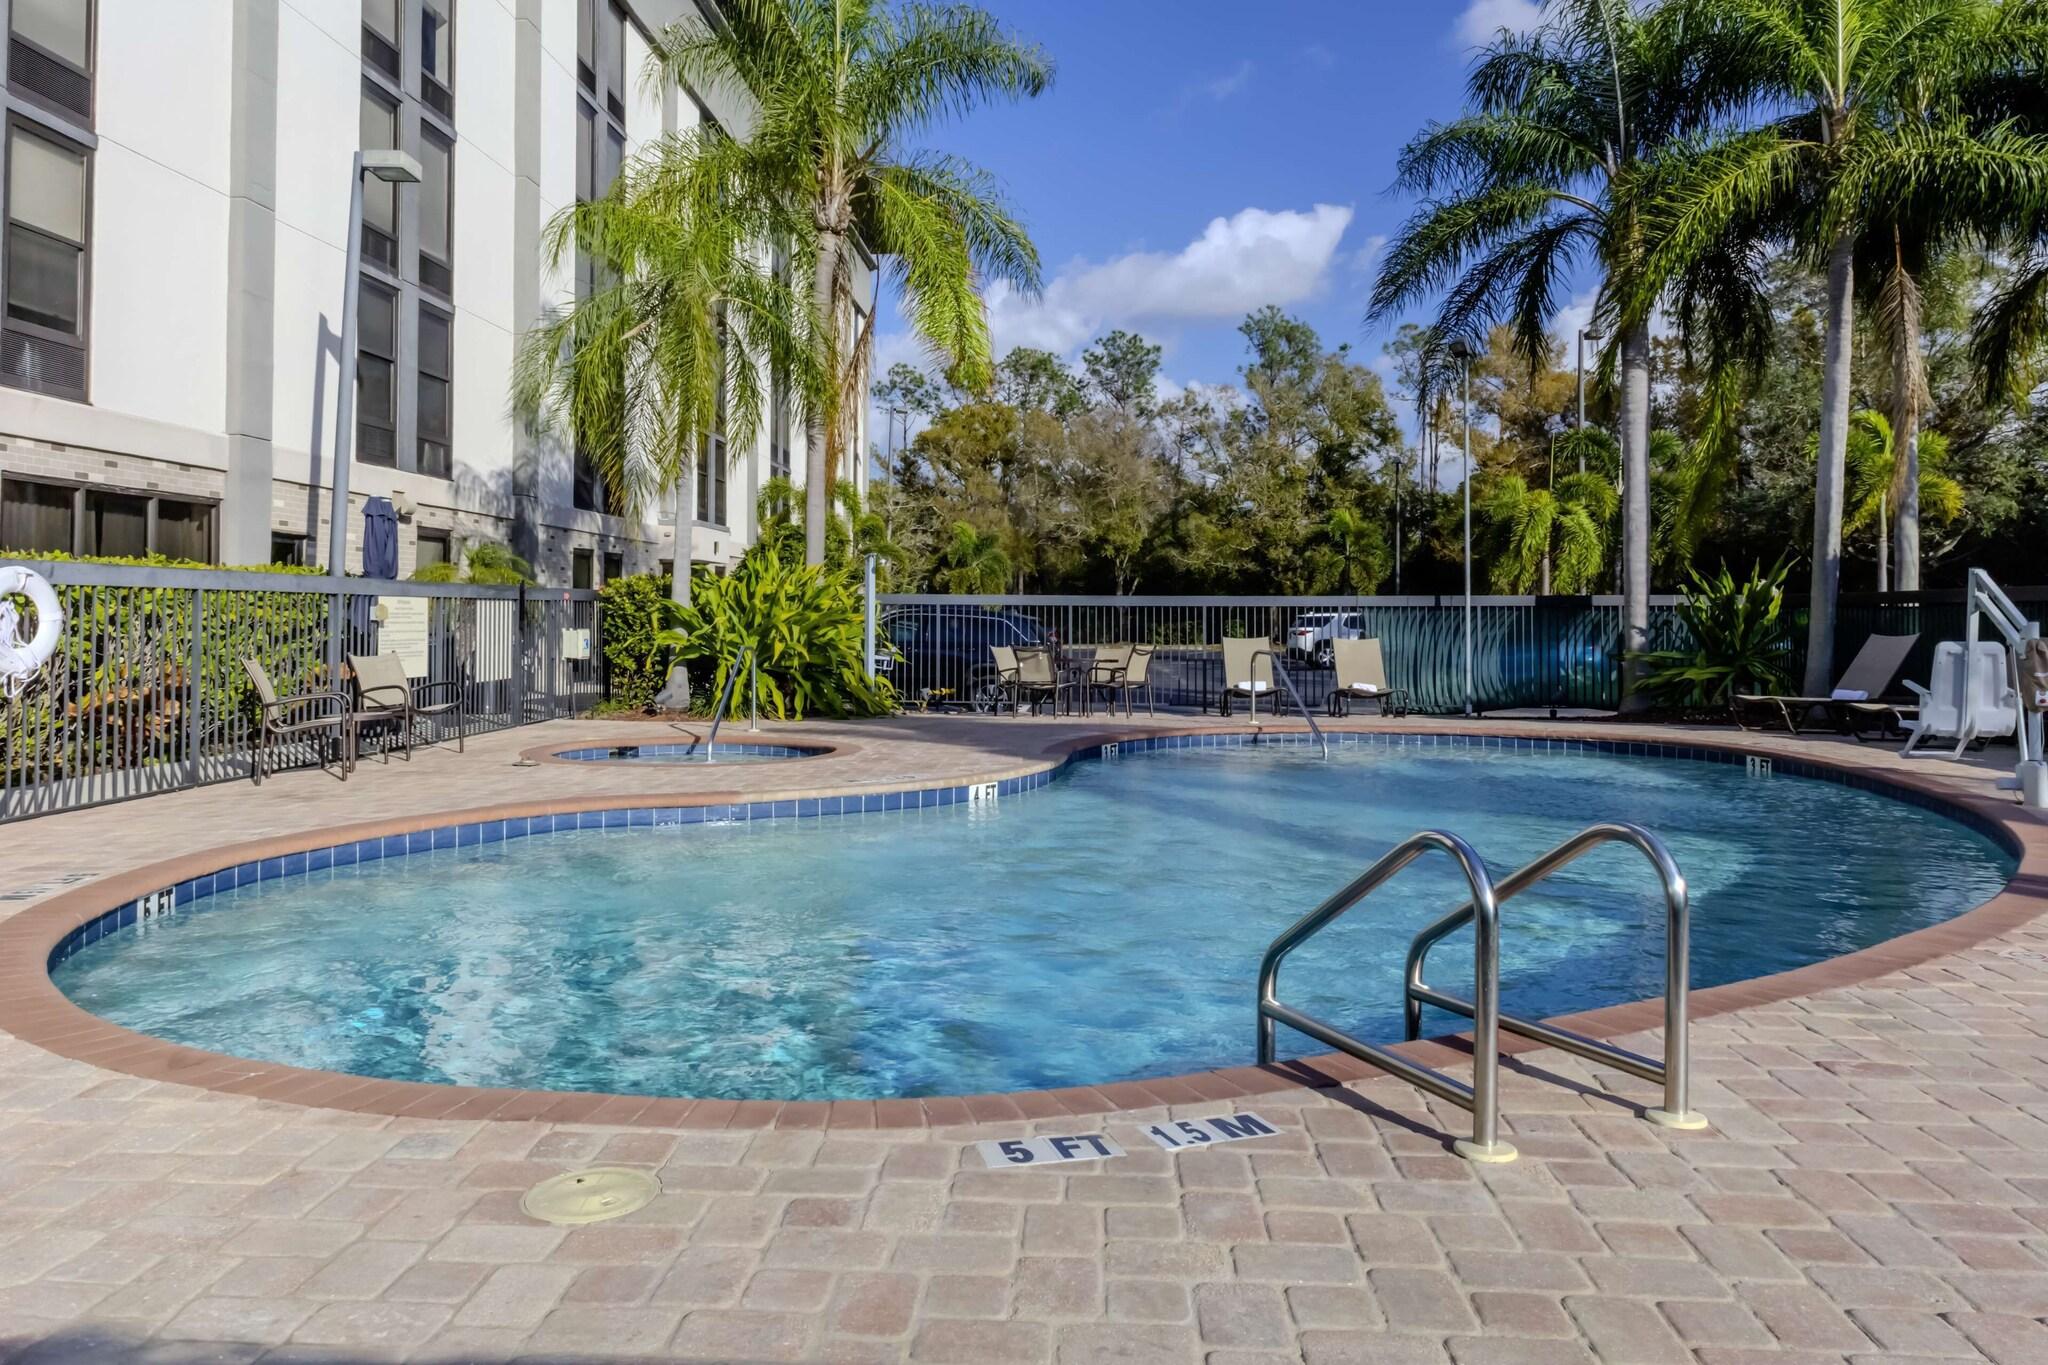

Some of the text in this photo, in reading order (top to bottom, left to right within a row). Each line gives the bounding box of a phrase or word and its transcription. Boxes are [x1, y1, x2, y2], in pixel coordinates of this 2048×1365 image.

[1760, 758, 1770, 773] FT
[974, 784, 997, 801] 4 FT
[158, 888, 173, 913] FT
[999, 1114, 1277, 1164] 5 FT 1.5 M
